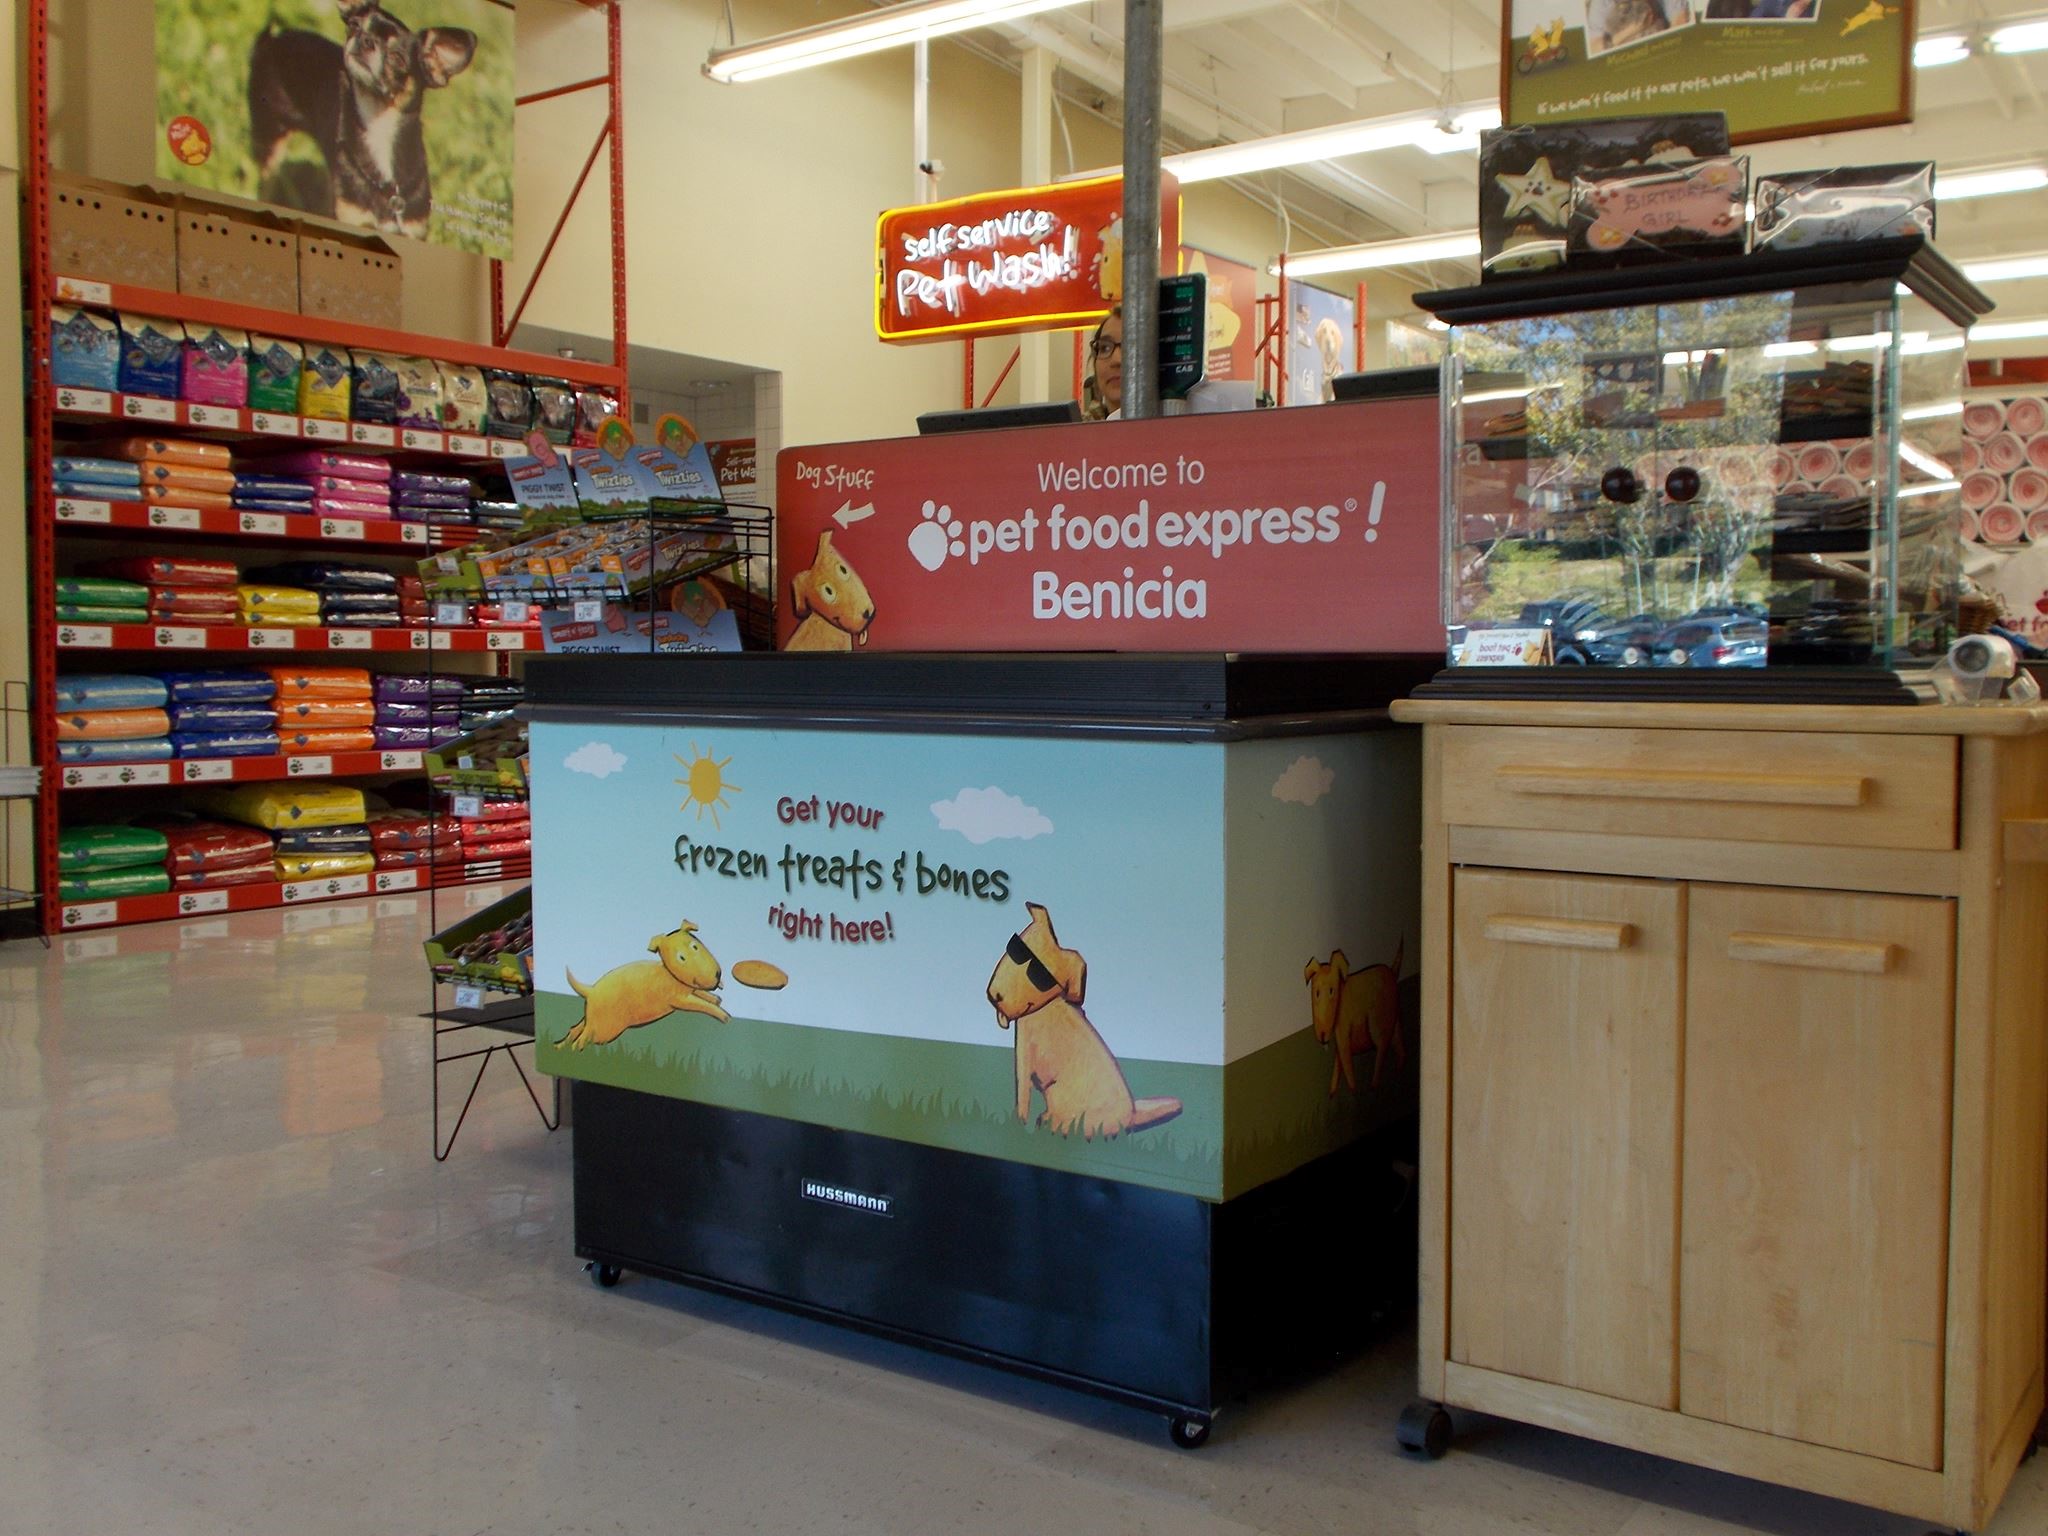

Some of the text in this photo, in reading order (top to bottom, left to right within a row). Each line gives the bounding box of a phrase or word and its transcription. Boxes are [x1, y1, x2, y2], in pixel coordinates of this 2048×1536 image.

[1712, 74, 1731, 86] we
[1771, 61, 1793, 77] sell
[1795, 59, 1806, 75] it
[1810, 57, 1828, 70] for
[904, 209, 1052, 262] self service
[1642, 211, 1690, 227] GIRL
[896, 258, 966, 317] Pet
[721, 467, 738, 481] Pet
[796, 461, 875, 493] Dog Stuff
[1037, 455, 1205, 493] Welcome to
[969, 508, 1040, 566] pet
[1046, 499, 1149, 550] food
[1032, 565, 1207, 620] Benicia
[777, 795, 885, 830] Get your
[674, 834, 1010, 901] frozen treats & bones
[768, 902, 894, 943] right here!
